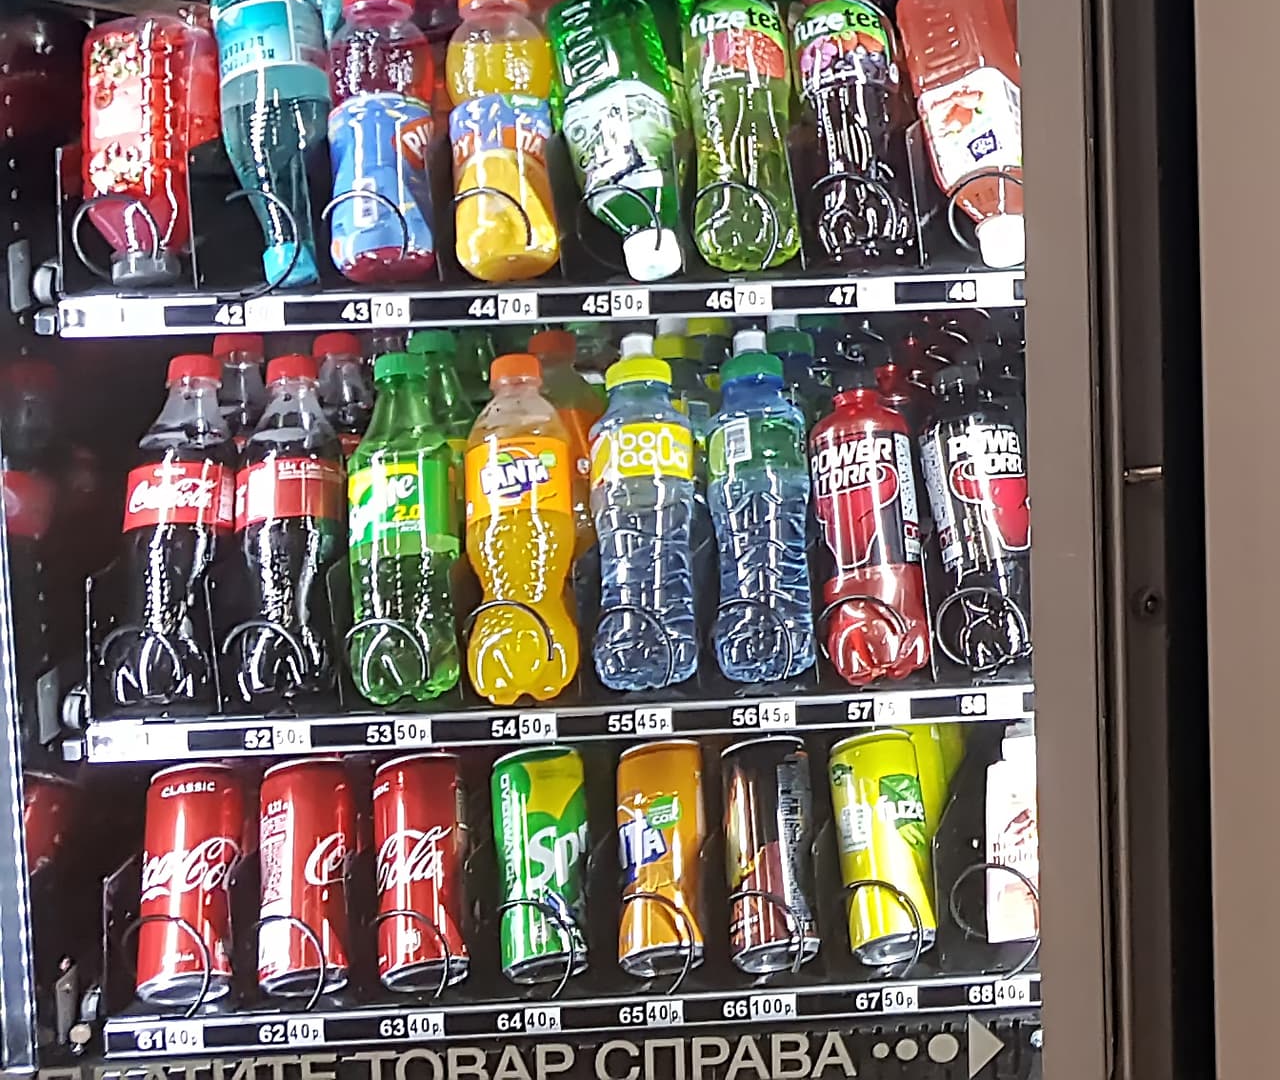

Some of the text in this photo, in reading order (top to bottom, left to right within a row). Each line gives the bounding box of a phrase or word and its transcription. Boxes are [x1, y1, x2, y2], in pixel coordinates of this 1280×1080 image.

[689, 11, 748, 39] fuze
[468, 299, 497, 319] 44
[582, 296, 609, 315] 45
[706, 291, 733, 310] 46
[341, 302, 370, 322] 43
[607, 714, 635, 733] 55
[732, 708, 757, 726] 56
[366, 724, 396, 744] 53
[491, 720, 517, 738] 54
[161, 780, 217, 798] CLASSIC
[722, 1000, 749, 1019] 66
[855, 993, 881, 1012] 67
[497, 1012, 522, 1031] 64
[619, 1006, 644, 1025] 65
[258, 1023, 286, 1044] 62
[379, 1018, 406, 1037] 63
[594, 1030, 858, 1080] СПРАВА
